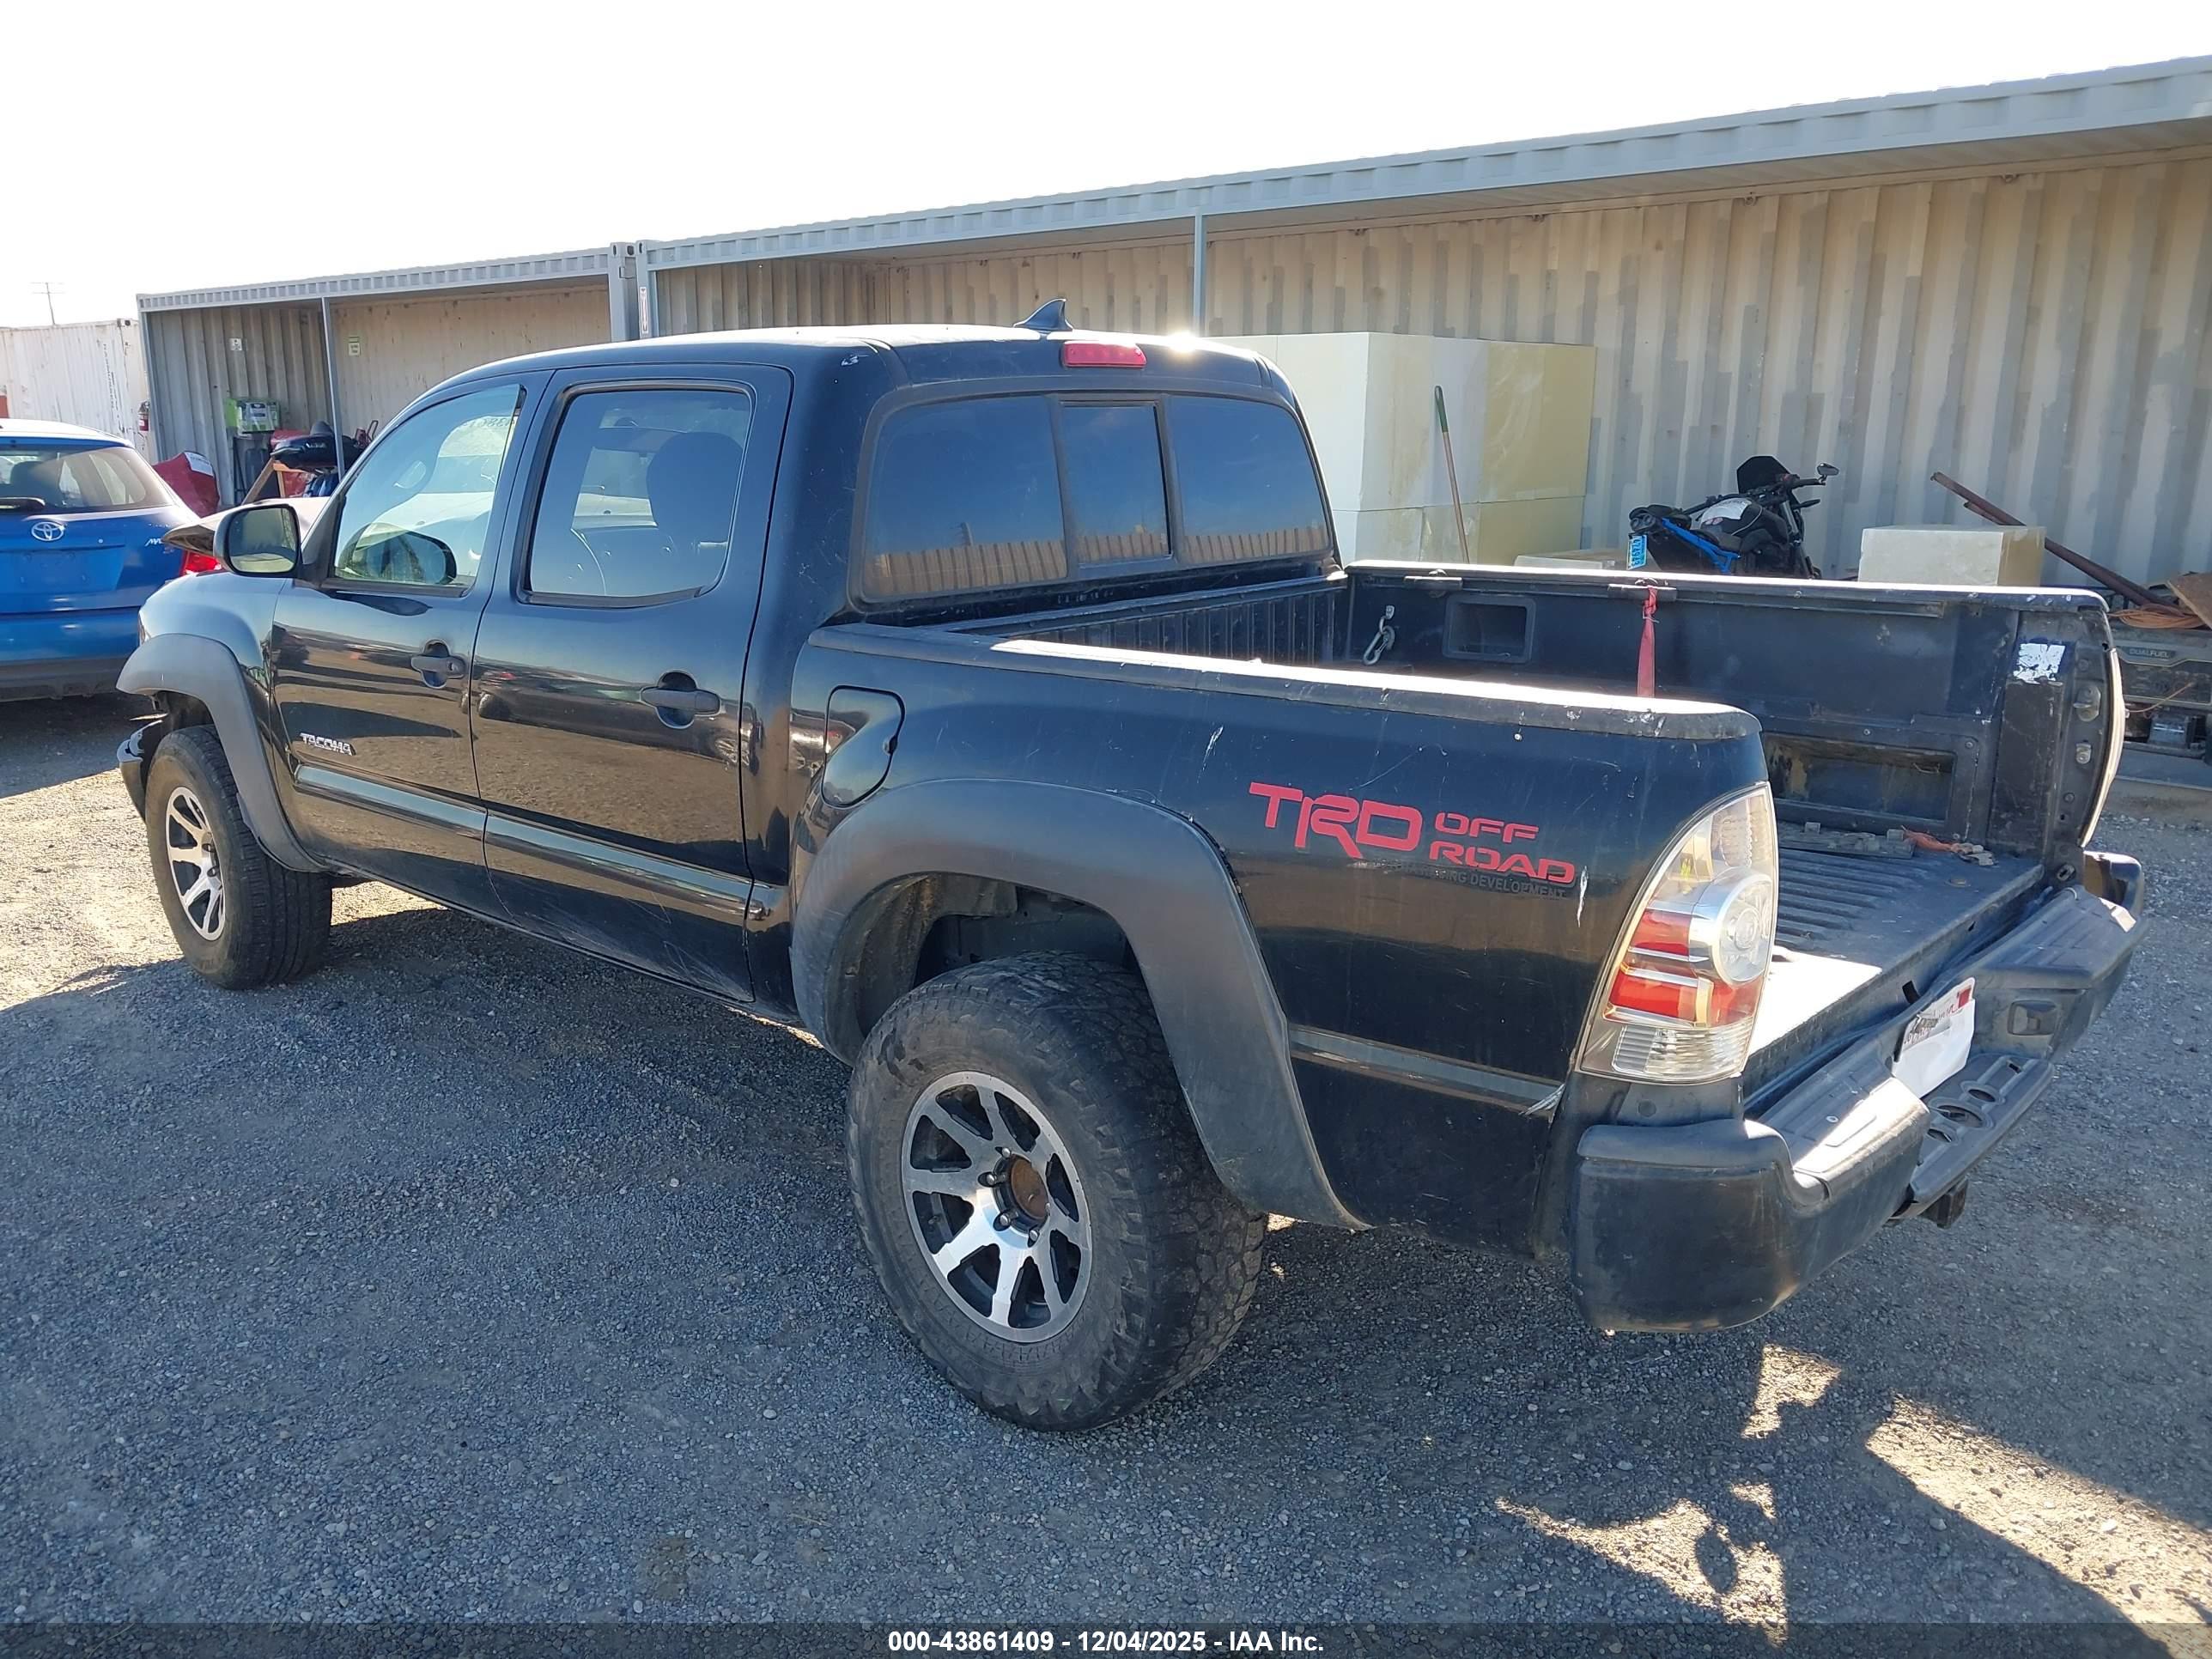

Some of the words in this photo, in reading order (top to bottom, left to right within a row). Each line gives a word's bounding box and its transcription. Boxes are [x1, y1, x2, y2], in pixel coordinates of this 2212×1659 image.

[300, 732, 353, 756] TACOMA
[1249, 781, 1423, 859] TRD
[1434, 811, 1540, 843] OFF
[1429, 841, 1576, 884] ROAD
[1470, 875, 1567, 896] DEVELOPMENT
